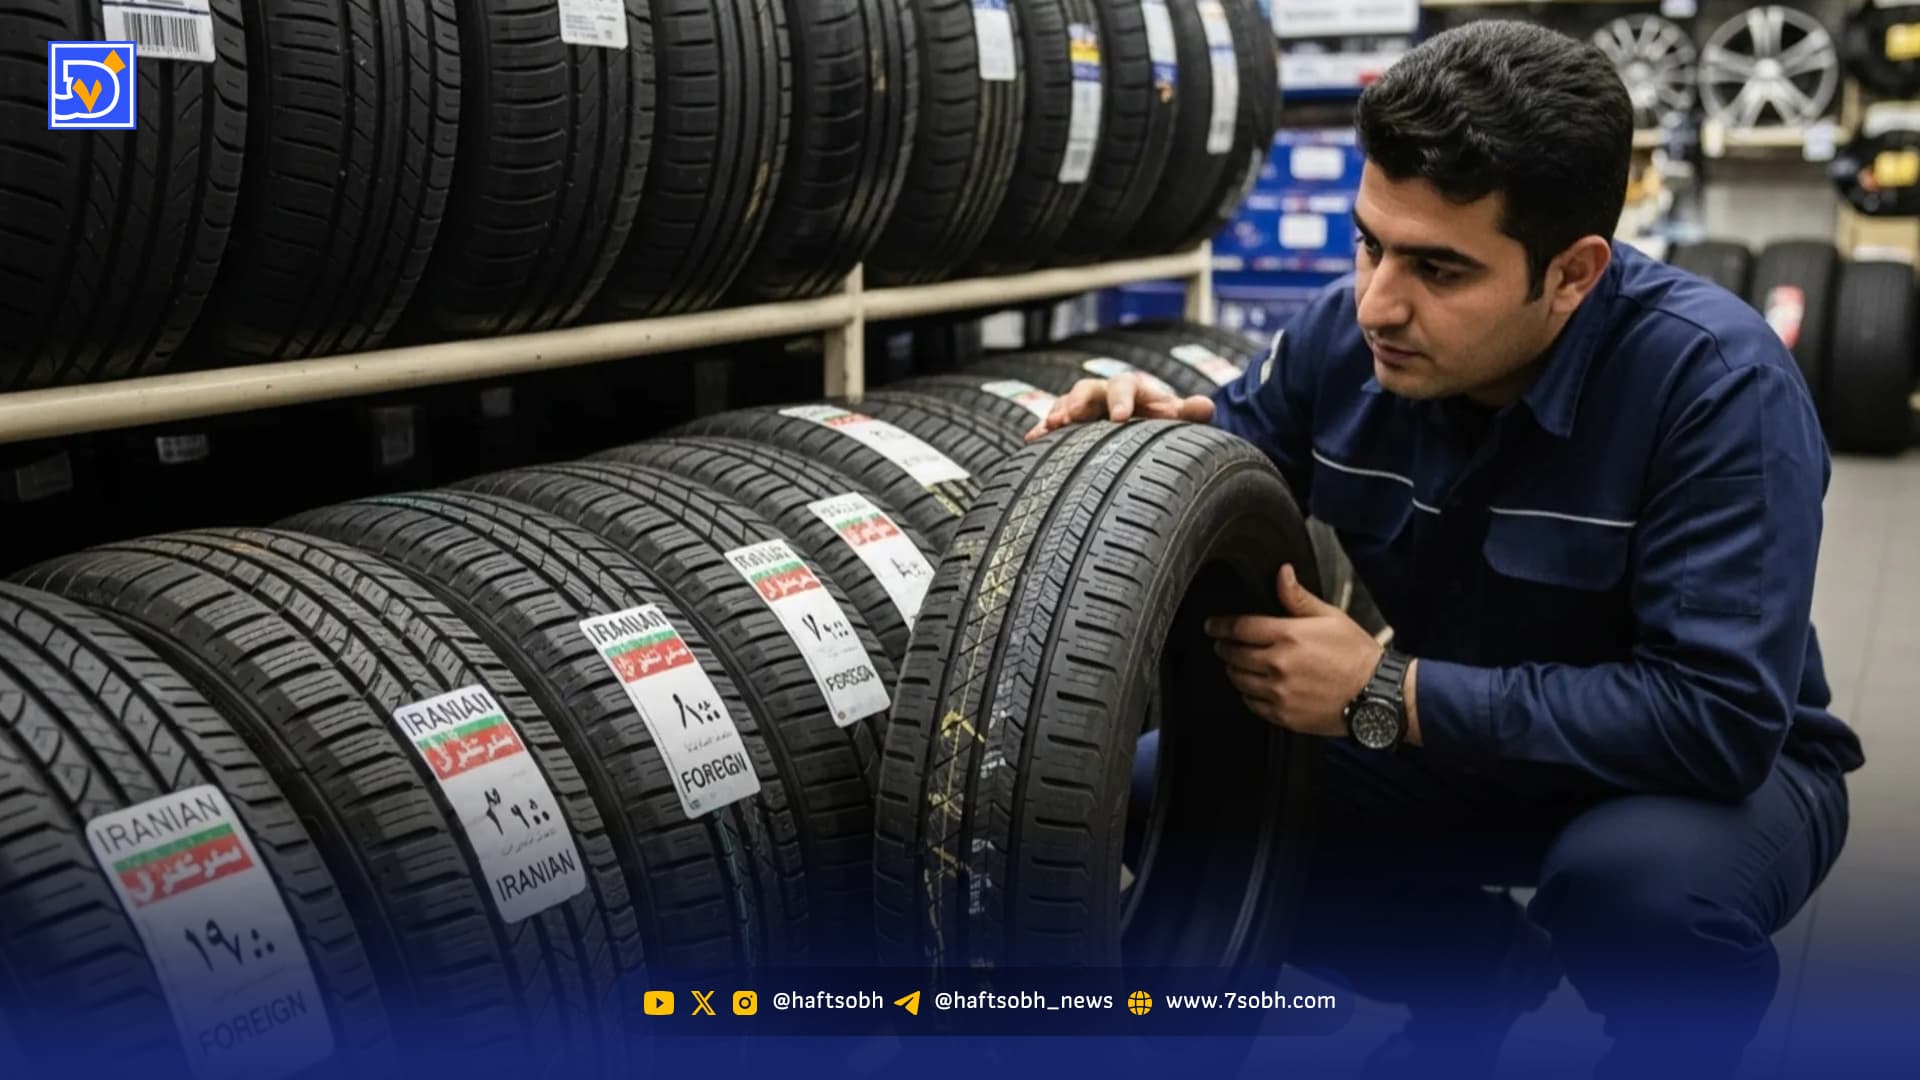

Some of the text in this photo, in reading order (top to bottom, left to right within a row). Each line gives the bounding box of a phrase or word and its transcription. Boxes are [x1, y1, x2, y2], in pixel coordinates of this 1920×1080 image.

[95, 793, 223, 855] IRANIAN
[496, 849, 576, 902] IRANIAN
[198, 990, 309, 1054] FOREIGN
